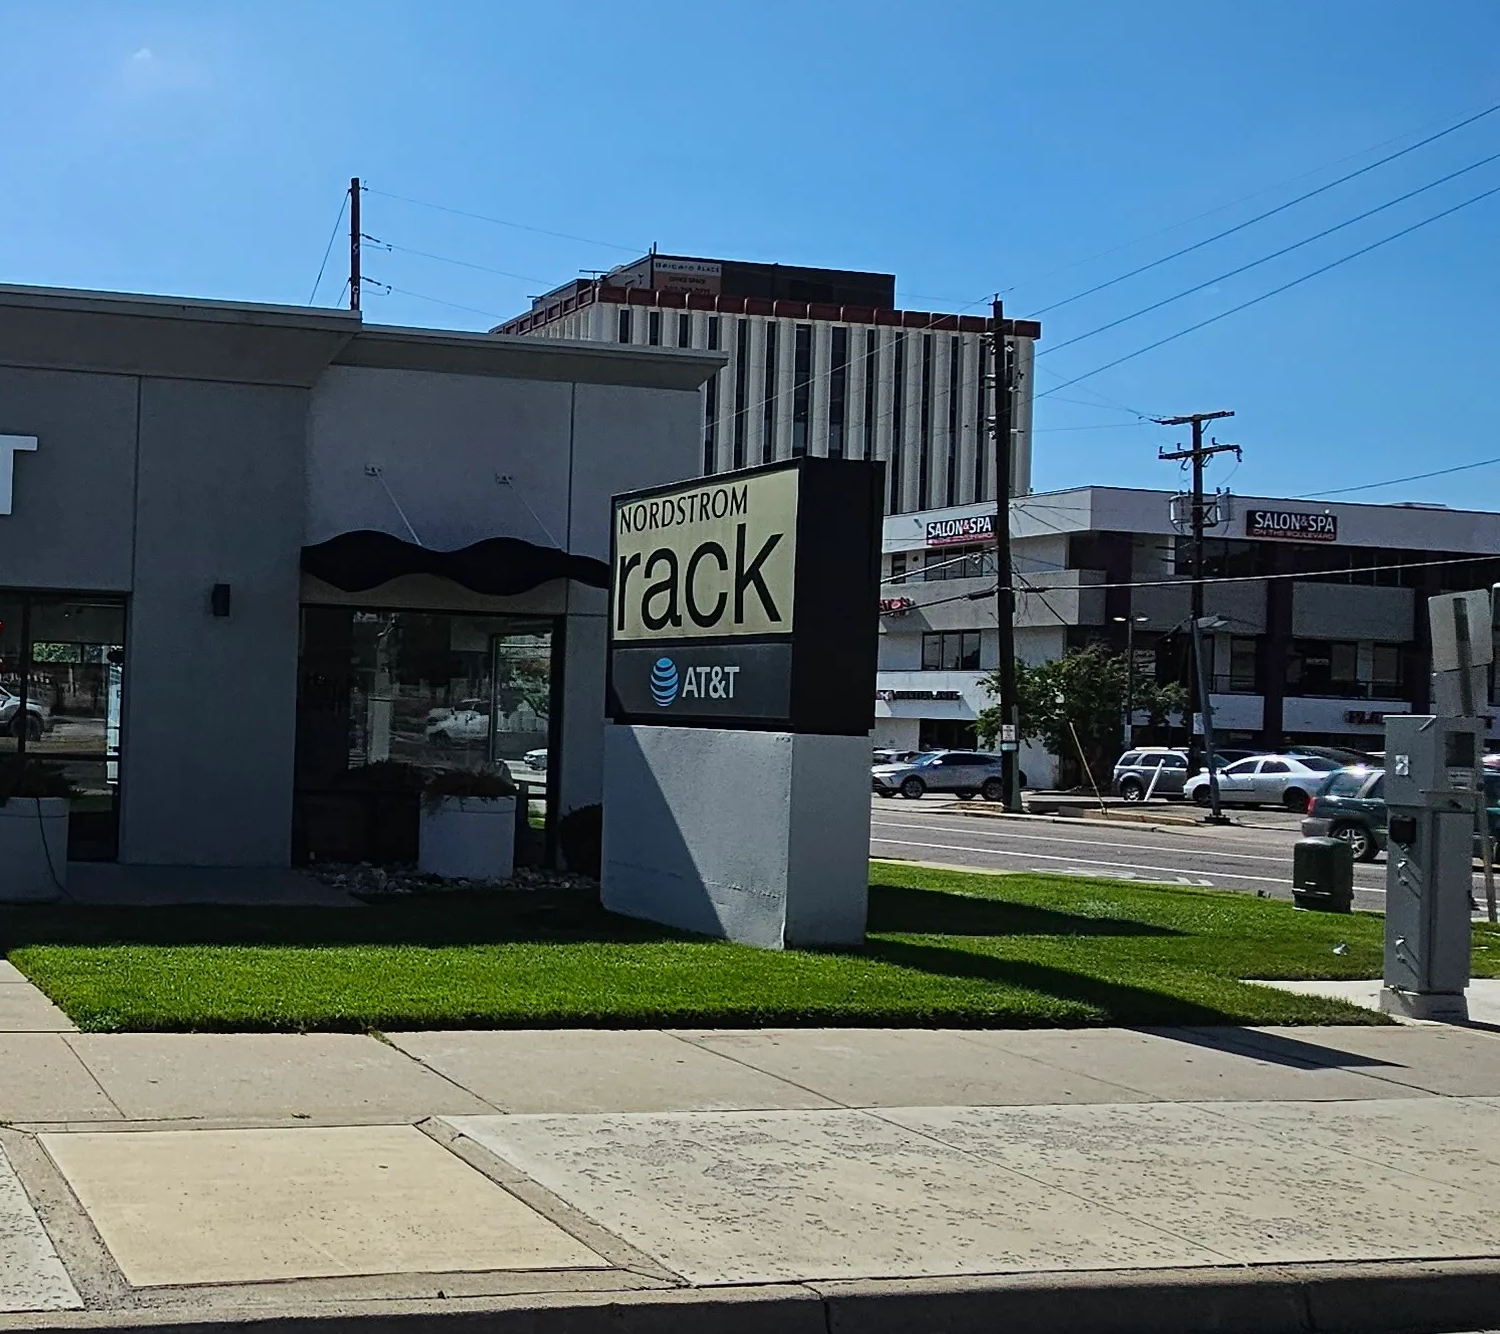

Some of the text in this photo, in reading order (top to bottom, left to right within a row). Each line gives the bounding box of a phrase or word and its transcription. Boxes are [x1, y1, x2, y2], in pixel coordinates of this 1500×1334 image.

[688, 277, 706, 285] SPACE
[619, 484, 748, 534] NORDSTROM
[1286, 530, 1335, 540] BOULEVARD
[617, 522, 784, 631] rack
[682, 666, 740, 699] AT&T
